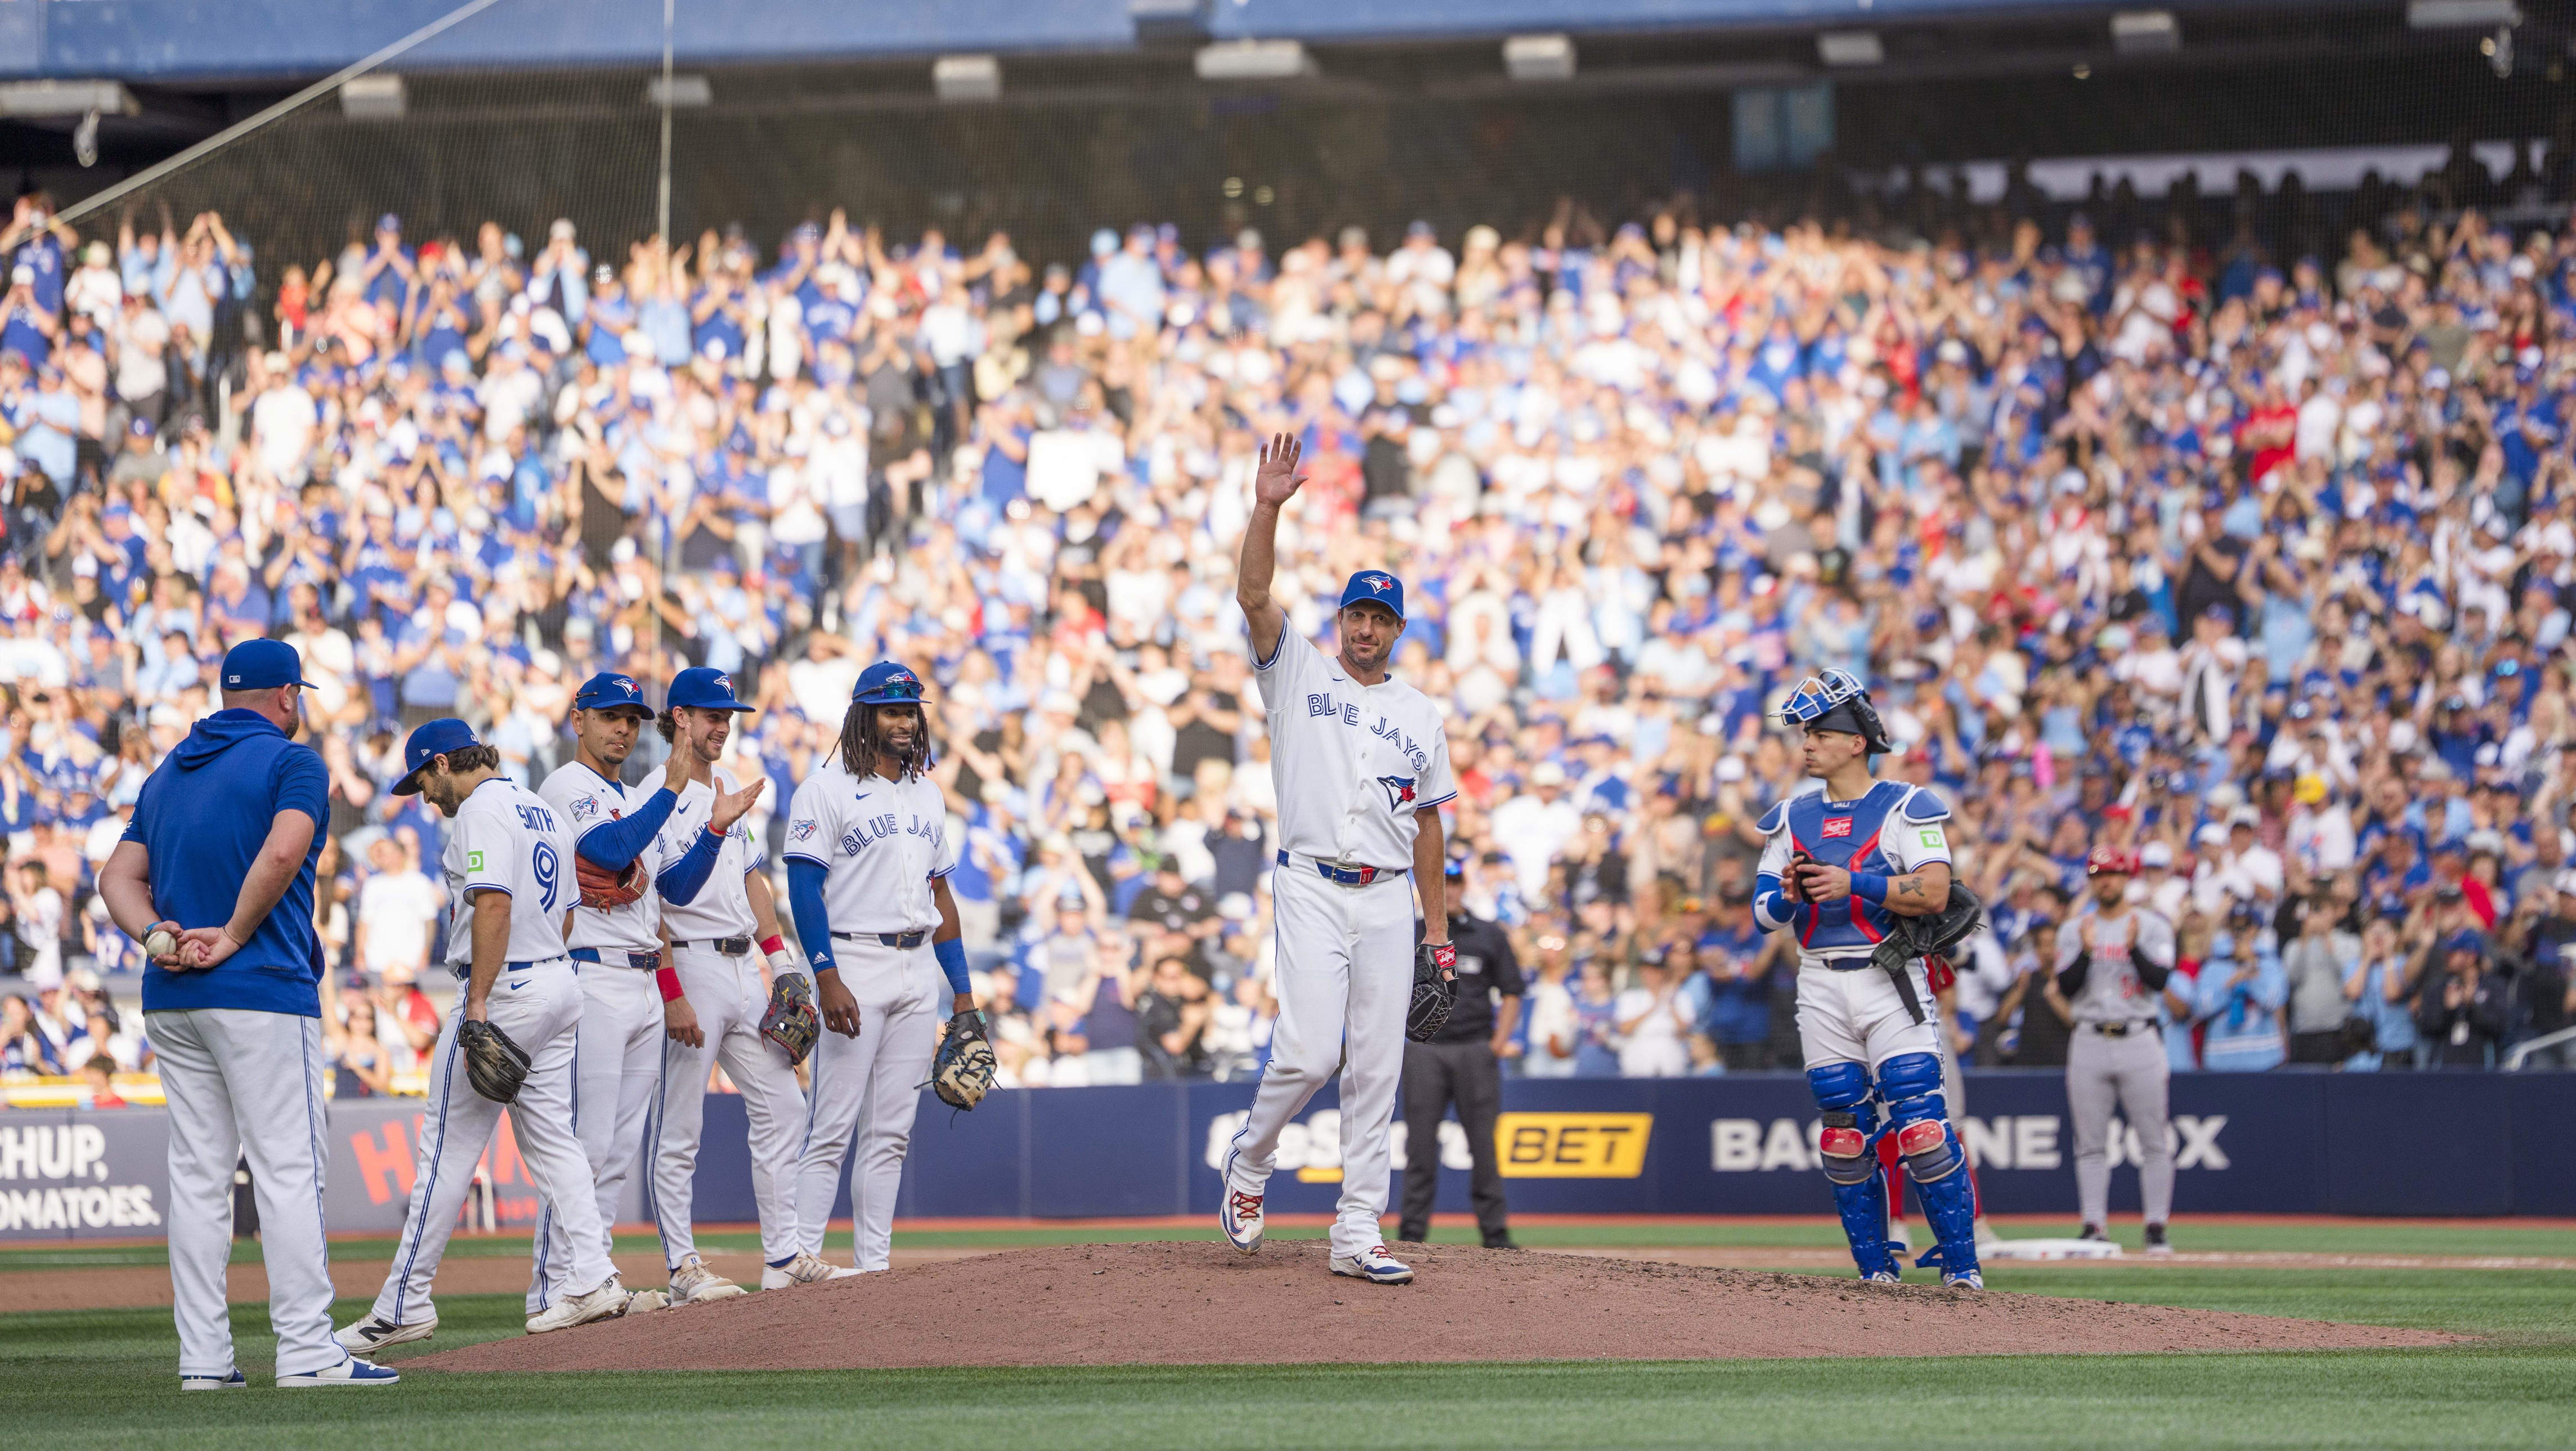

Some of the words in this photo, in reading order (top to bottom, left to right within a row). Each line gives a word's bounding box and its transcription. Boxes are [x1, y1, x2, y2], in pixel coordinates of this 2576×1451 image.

[1370, 716, 1427, 771] JAYS
[841, 814, 898, 857] BLUE
[532, 840, 559, 914] 9
[1362, 873, 1371, 883] 31
[1509, 1127, 1632, 1165] BET
